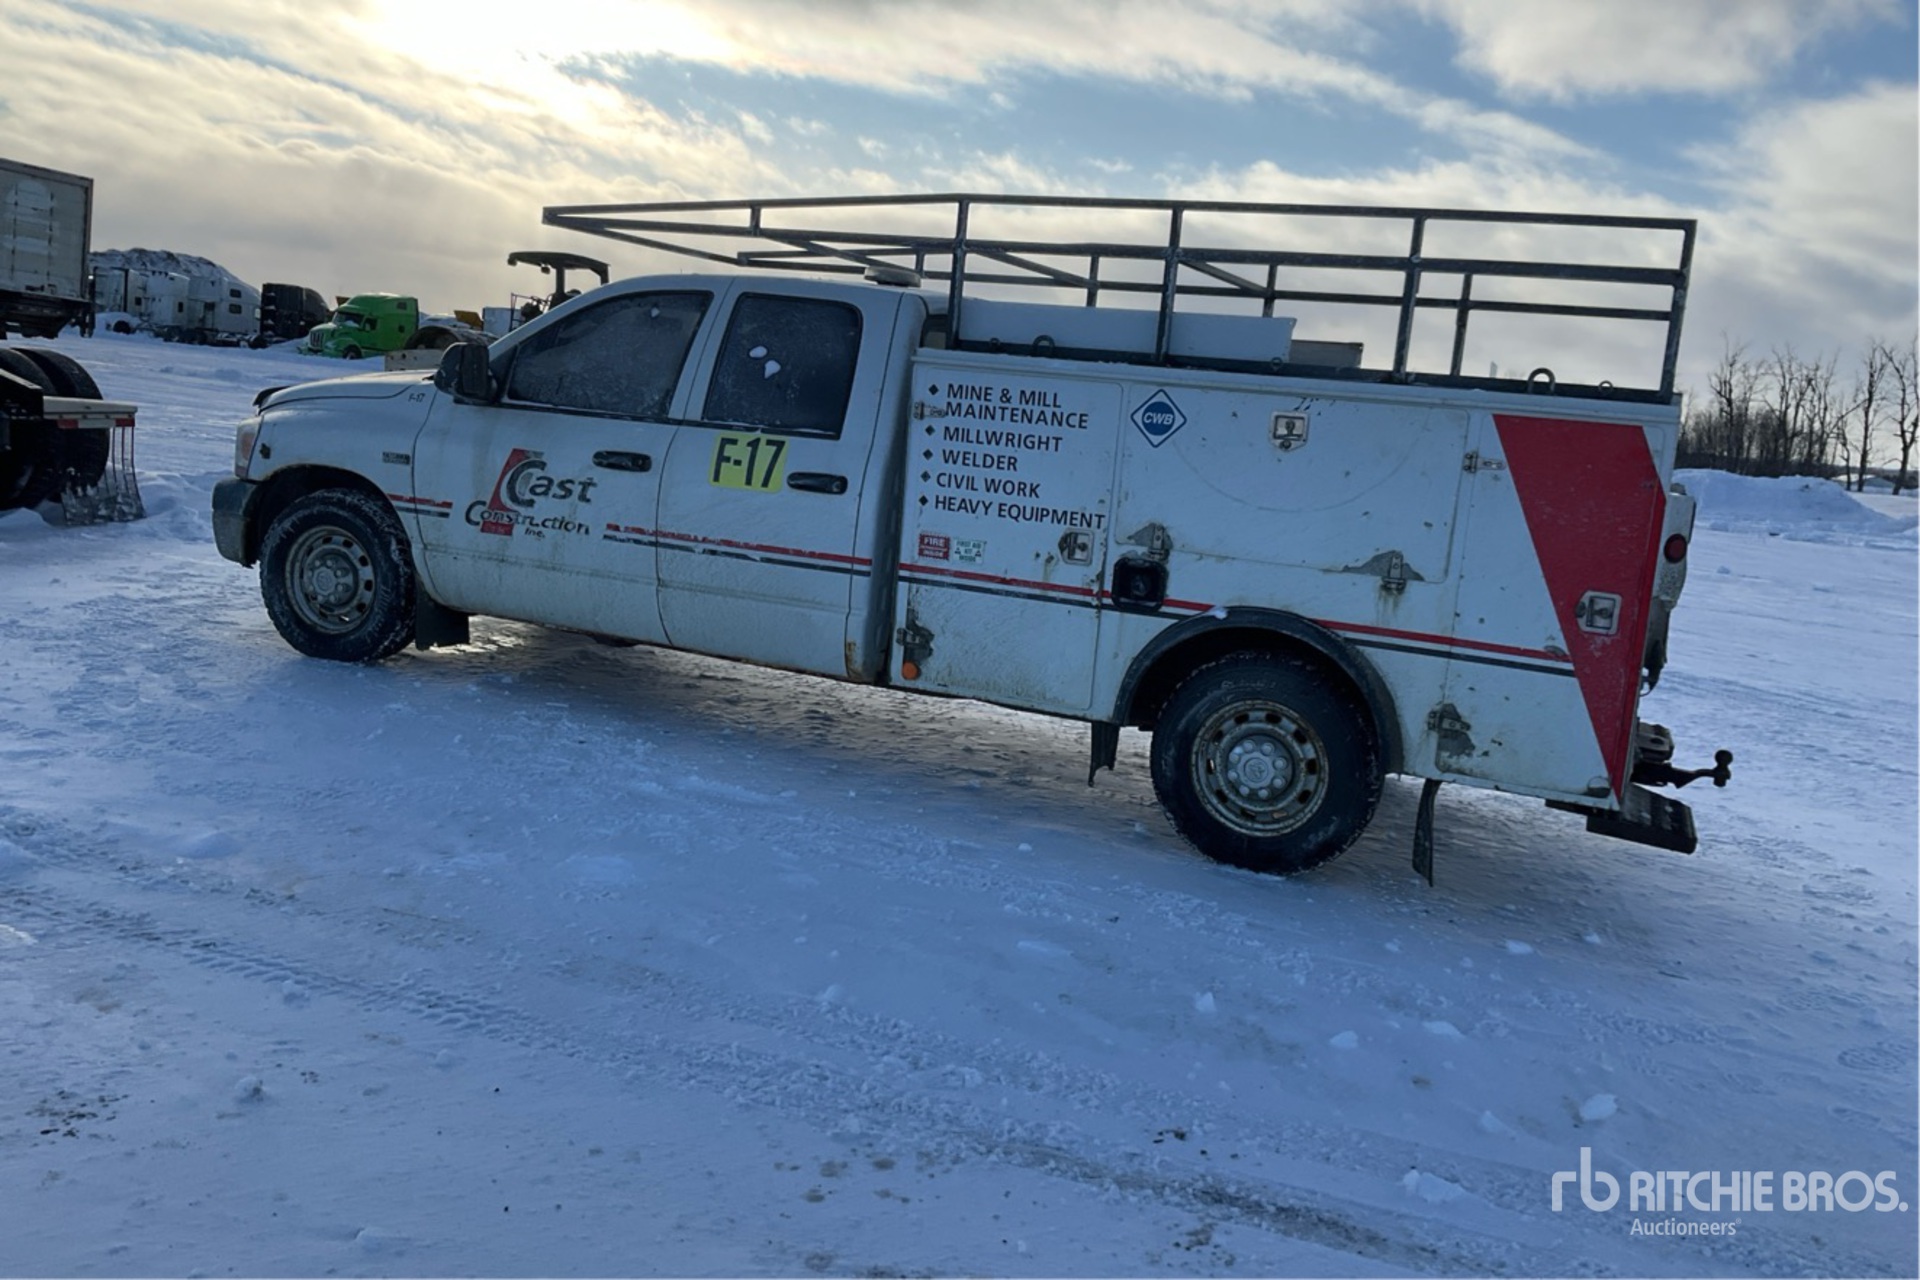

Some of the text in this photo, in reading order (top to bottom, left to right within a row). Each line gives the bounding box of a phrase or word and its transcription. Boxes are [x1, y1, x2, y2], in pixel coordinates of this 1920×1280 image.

[947, 383, 1062, 409] MINE & MILL
[945, 401, 1089, 430] MAINTENANCE
[1143, 412, 1174, 425] CWB
[943, 426, 1063, 452] MILLWRIGHT
[713, 437, 786, 488] F-17
[942, 449, 1018, 472] WELDER
[506, 459, 598, 508] Cast
[936, 472, 1041, 499] CIVIL WORK
[935, 495, 1106, 530] HEAVY EQUIPMENT
[923, 537, 946, 548] FIRE
